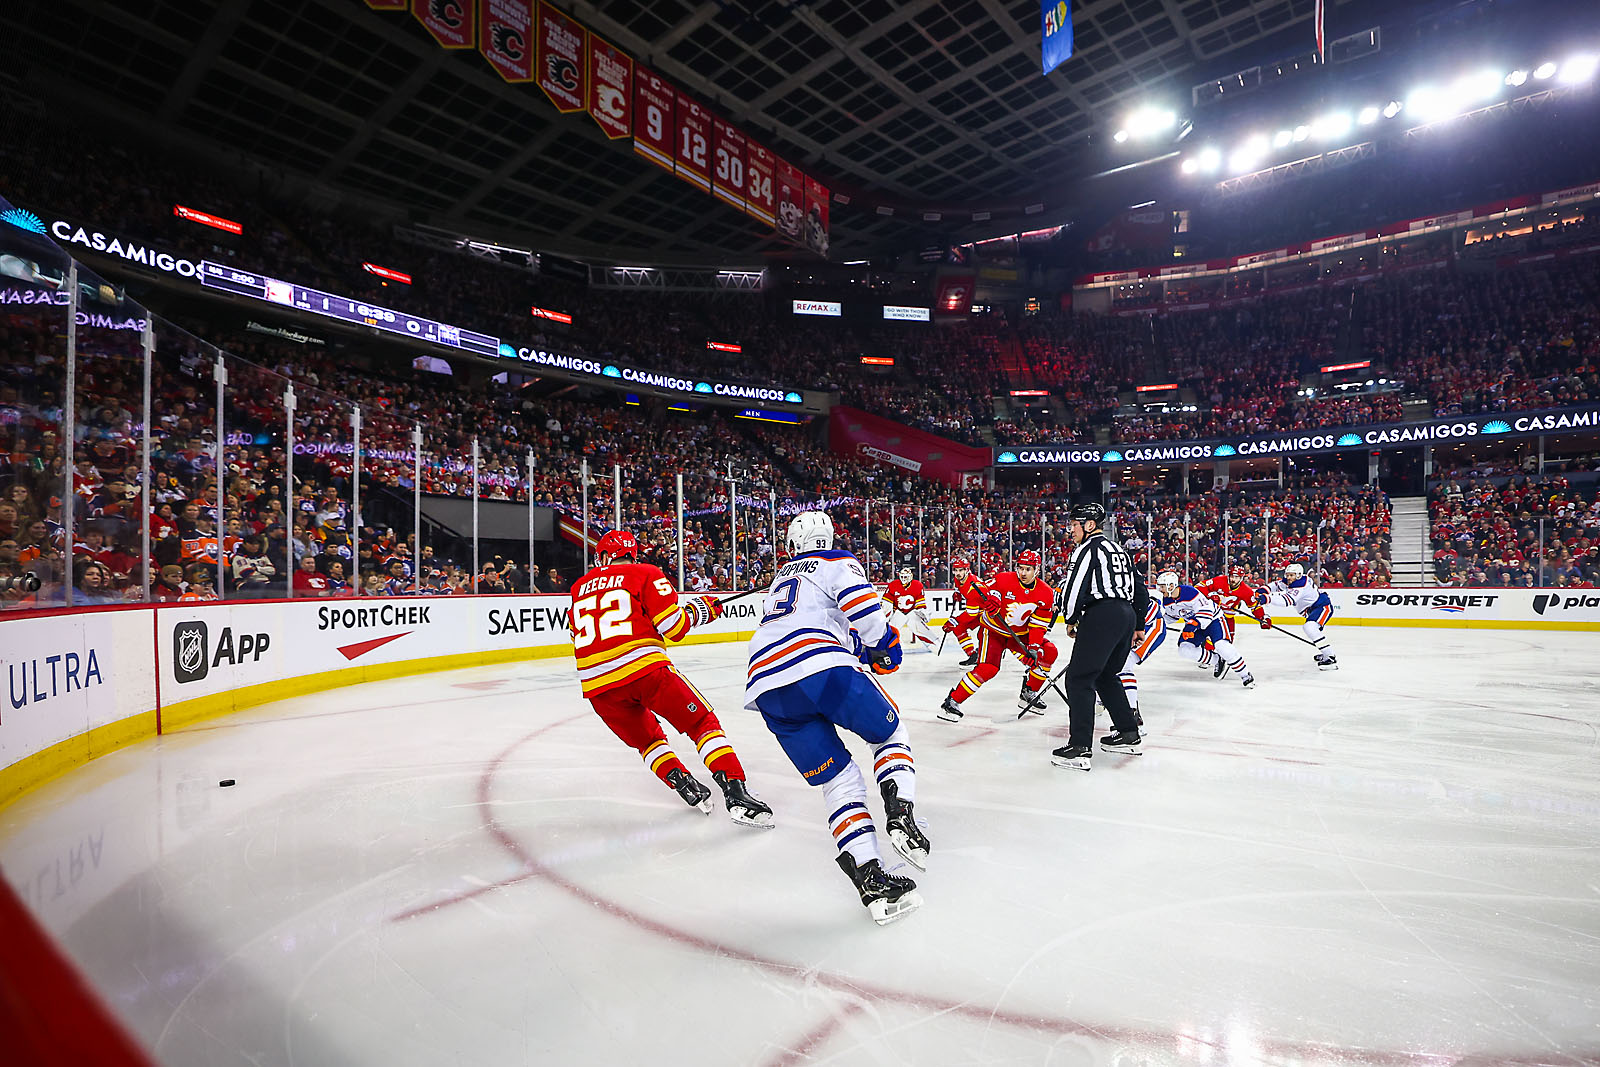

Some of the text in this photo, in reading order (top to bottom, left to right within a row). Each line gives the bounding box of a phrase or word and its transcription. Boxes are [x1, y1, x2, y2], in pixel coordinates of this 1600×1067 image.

[647, 104, 662, 141] 9
[682, 126, 706, 168] 12
[716, 147, 743, 188] 30
[748, 167, 773, 206] 34
[406, 320, 421, 333] 0
[518, 347, 601, 375] CASAMIGOS
[622, 368, 694, 392] CASAMIGOS
[714, 383, 784, 402] CASAMIGOS
[1365, 422, 1478, 444] CASAMIGOS
[1124, 445, 1212, 461] CASAMIGOS
[1237, 434, 1335, 455] CASAMIGOS
[1019, 451, 1101, 463] CASAMIGOS
[622, 539, 636, 548] 52
[815, 539, 827, 549] 93
[1111, 553, 1129, 573] 92
[1287, 588, 1300, 597] 29
[1356, 594, 1499, 608] SPORTSNET
[573, 589, 633, 650] 52
[9, 648, 103, 710] ULTRA
[803, 757, 835, 778] BAUER
